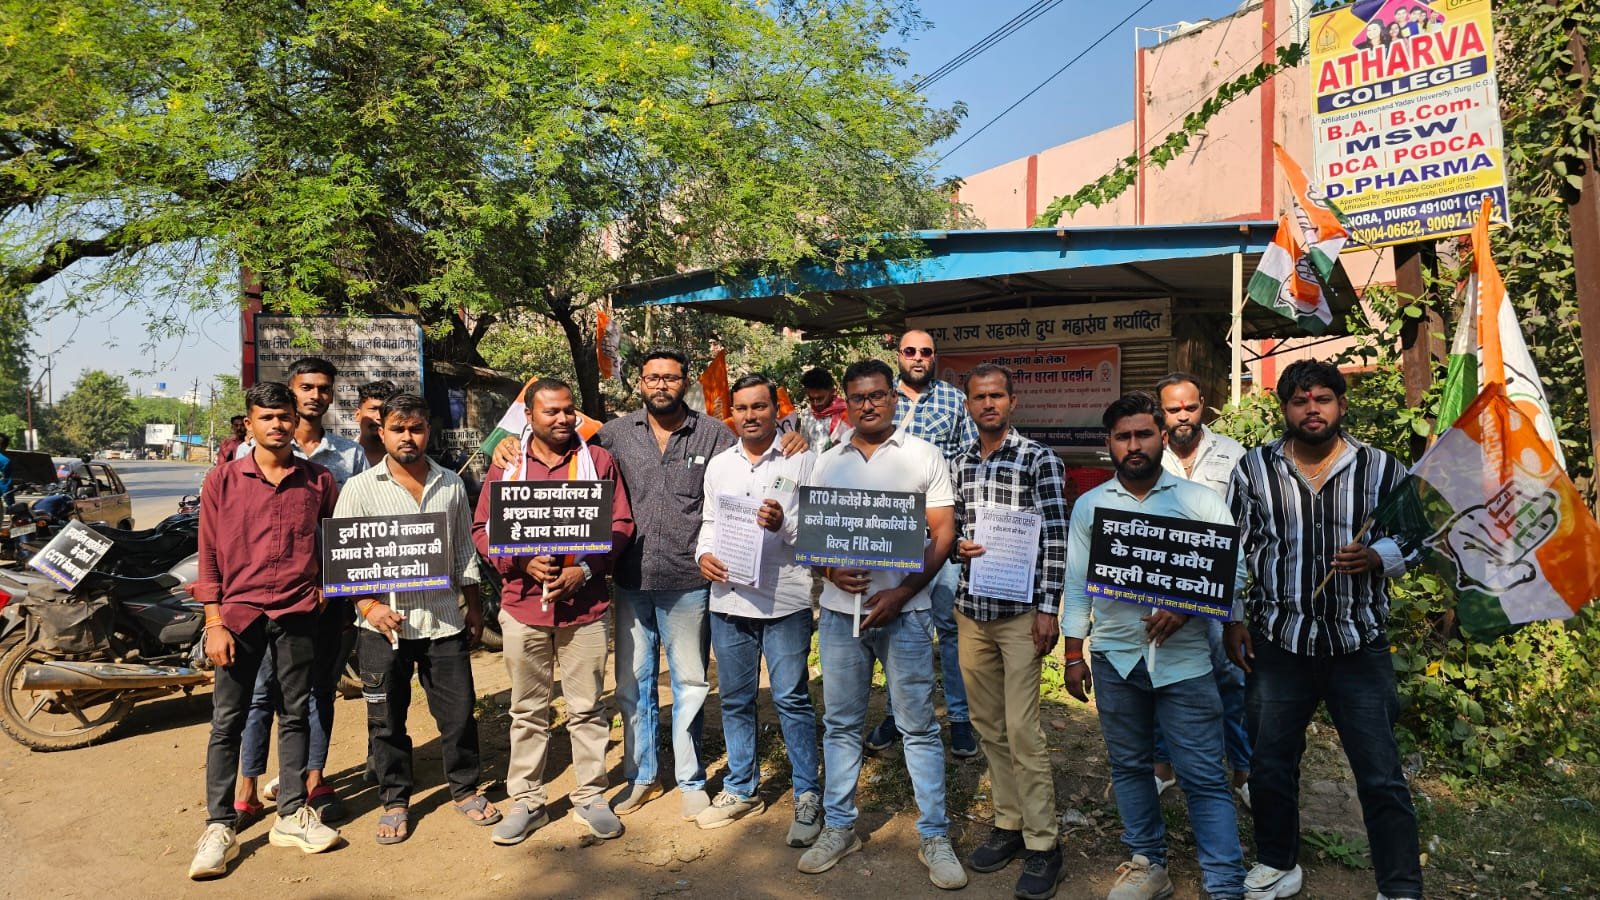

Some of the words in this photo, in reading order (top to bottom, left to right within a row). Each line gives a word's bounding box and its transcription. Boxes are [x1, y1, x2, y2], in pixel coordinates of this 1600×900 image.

[1318, 22, 1485, 94] ATHARVA
[1332, 61, 1473, 108] COLLEGE
[1395, 97, 1416, 111] Yadav
[1454, 84, 1472, 97] Durg
[1327, 120, 1374, 141] B.A.
[1390, 96, 1480, 126] B.Com.
[1346, 116, 1457, 155] MSW
[1329, 155, 1378, 177] DCA
[1394, 132, 1485, 164] PGDCA
[1326, 153, 1494, 198] D.PHARMA
[1340, 193, 1371, 206] Approved
[1386, 184, 1420, 197] Pharmacy
[1421, 182, 1447, 192] Council
[1448, 178, 1456, 186] of
[1438, 184, 1455, 195] Durg
[1384, 205, 1417, 221] DURG
[1420, 198, 1461, 215] 491001
[1427, 205, 1502, 231] 90097-1622
[953, 324, 981, 342] राज्य
[986, 318, 1031, 341] सहकारी
[1062, 312, 1108, 336] महासंघ
[1112, 310, 1162, 332] मर्यादित
[1034, 370, 1059, 384] धरना
[1061, 367, 1093, 383] प्रदर्शन
[501, 486, 531, 501] RTO
[533, 484, 589, 500] कार्यालय
[591, 483, 603, 500] में
[809, 490, 830, 505] RTO
[862, 492, 872, 507] के
[872, 493, 892, 509] अवैध
[893, 495, 916, 514] वसूली
[553, 506, 576, 519] चल
[577, 506, 600, 520] रहा
[805, 512, 824, 526] करने
[824, 512, 841, 527] वाले
[841, 515, 864, 533] प्रमुख
[865, 514, 908, 531] अधिकारियों
[908, 516, 918, 531] के
[339, 522, 359, 544] दुर्ग
[360, 522, 387, 539] RTO
[390, 520, 399, 537] में
[401, 522, 435, 536] तत्काल
[510, 521, 522, 541] है
[524, 526, 551, 538] साय
[826, 534, 850, 551] विरुद्ध
[852, 536, 869, 551] FIR
[1102, 519, 1166, 540] ड्राइविंग
[1169, 528, 1233, 551] लाइसेंस
[46, 548, 67, 566] CCTV
[331, 547, 362, 561] प्रभाव
[364, 542, 374, 559] से
[375, 541, 397, 558] सभी
[399, 543, 427, 557] प्रकार
[428, 538, 442, 554] की
[1110, 539, 1130, 558] के
[1132, 546, 1167, 564] नाम
[1170, 550, 1215, 572] अवैध
[347, 563, 381, 582] दलाली
[383, 562, 400, 579] बंद
[1095, 563, 1144, 586] वसूली
[1146, 568, 1173, 590] बंद
